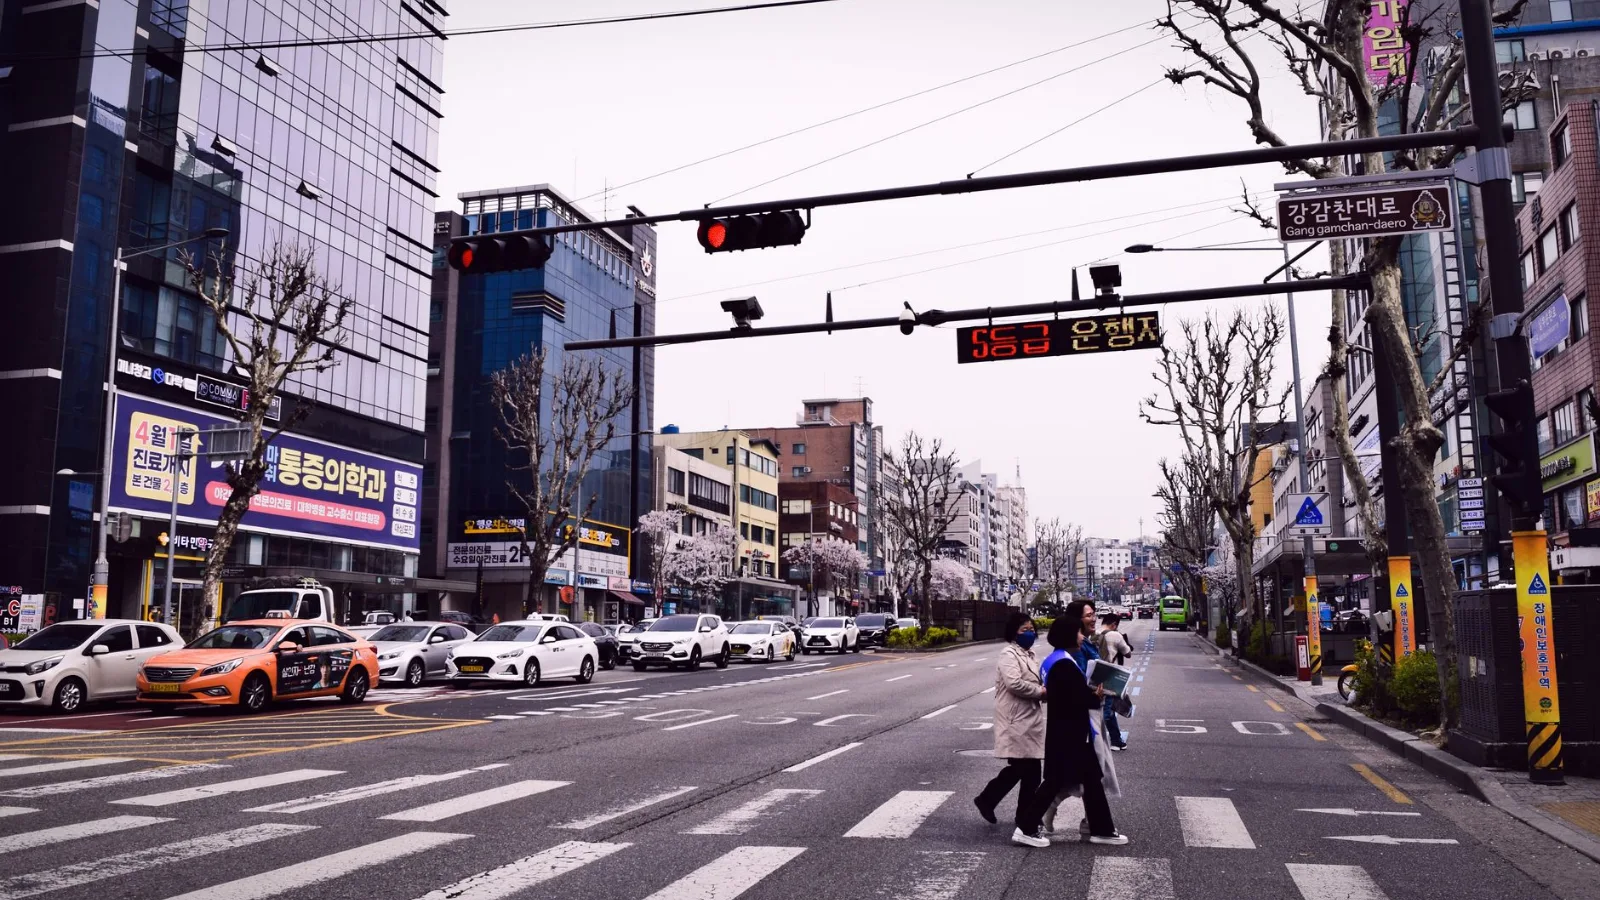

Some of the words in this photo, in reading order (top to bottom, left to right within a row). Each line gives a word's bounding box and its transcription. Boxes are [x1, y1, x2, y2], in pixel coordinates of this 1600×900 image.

[1288, 197, 1400, 225] 강감찬대로
[971, 323, 1050, 359] 5등급
[117, 358, 152, 380] 미니창고
[208, 383, 238, 401] COMMA
[132, 473, 141, 486] 본
[143, 475, 162, 490] 건물
[278, 447, 388, 502] 통증의학과
[253, 494, 292, 511] 전문의진료
[297, 501, 326, 516] 대학병원
[326, 505, 353, 520] 교수출신
[355, 510, 380, 525] 대표원장
[453, 545, 492, 555] 전문의진료
[453, 555, 507, 564] 수요일야간진료
[3, 617, 14, 626] B1
[1534, 602, 1551, 690] 장애인보호구역
[1154, 719, 1295, 735] 50
